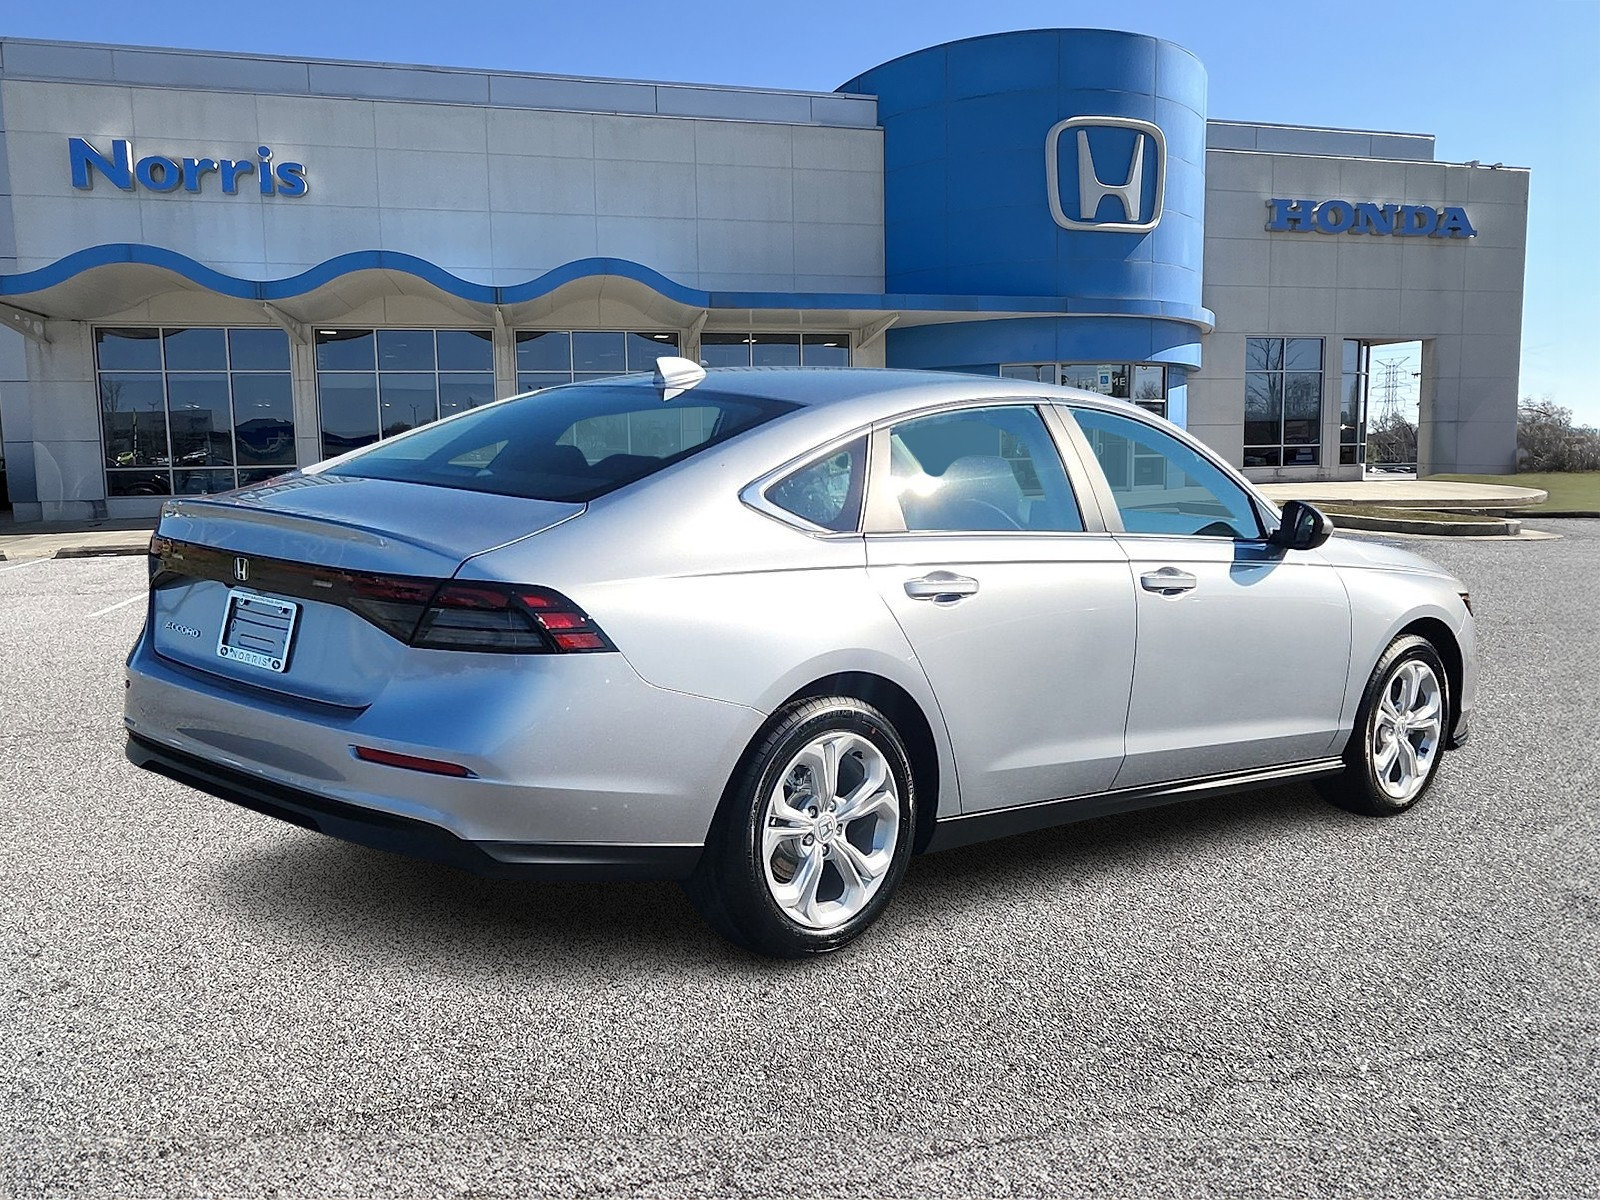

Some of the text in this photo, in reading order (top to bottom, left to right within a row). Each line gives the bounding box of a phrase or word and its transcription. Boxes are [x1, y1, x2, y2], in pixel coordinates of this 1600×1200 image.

[68, 137, 308, 197] Norris
[1266, 198, 1478, 239] HONDA
[165, 621, 200, 638] ACCORD
[231, 649, 269, 667] NORRIS
